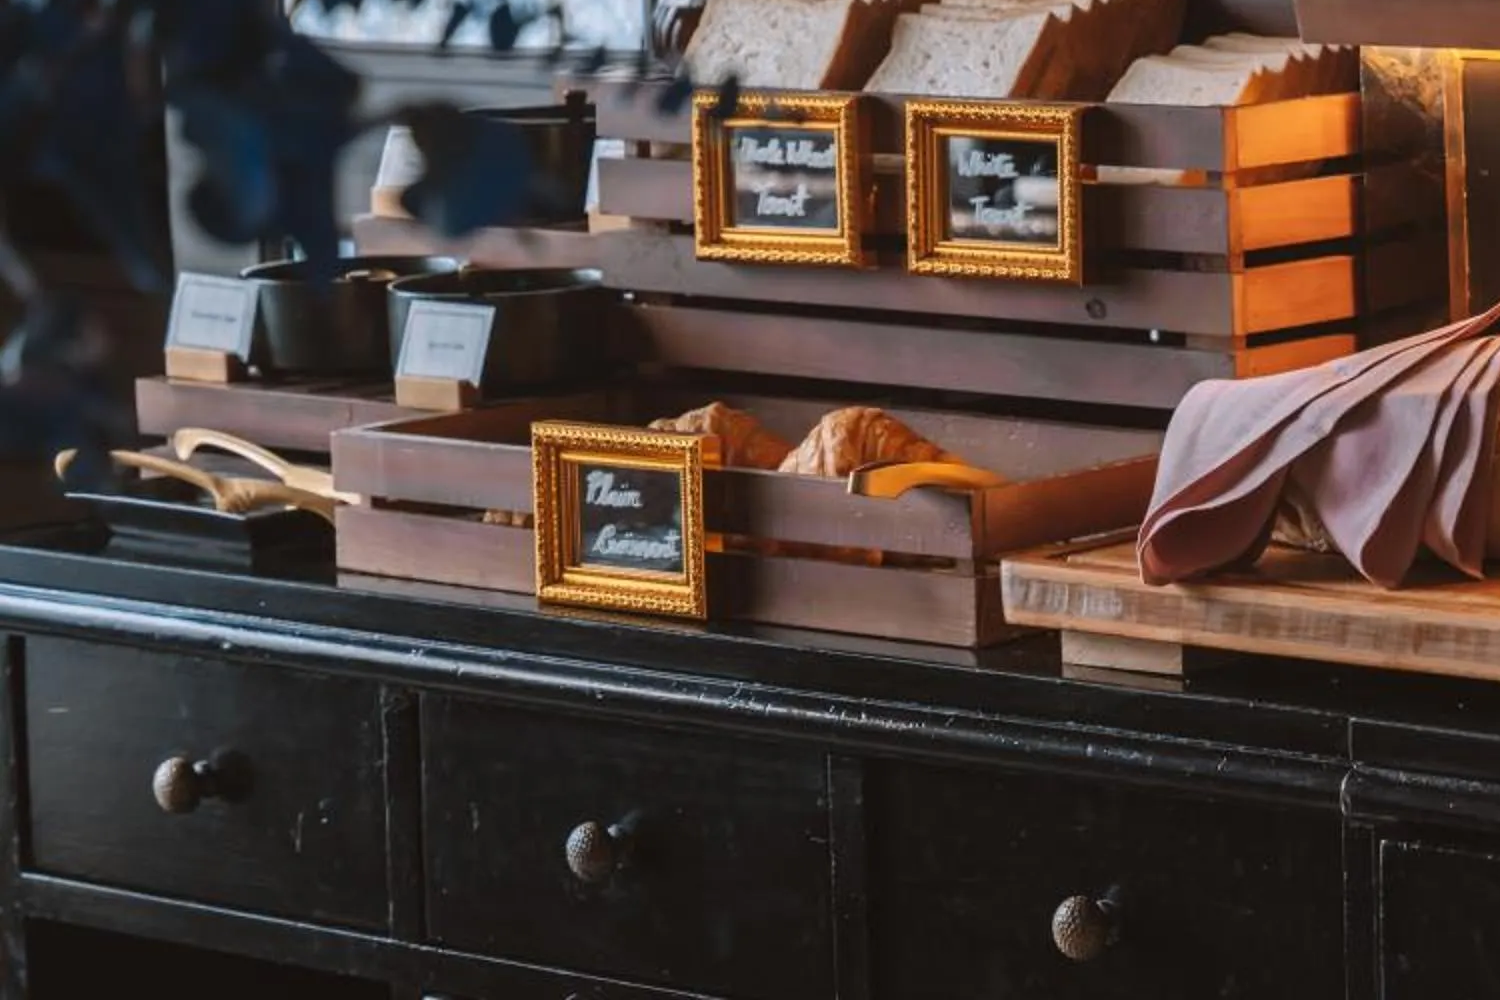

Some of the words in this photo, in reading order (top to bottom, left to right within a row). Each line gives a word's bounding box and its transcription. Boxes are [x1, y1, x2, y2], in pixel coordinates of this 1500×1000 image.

[957, 151, 1018, 179] White
[749, 181, 812, 218] Toast
[968, 195, 1035, 225] Toast
[586, 470, 644, 508] Plain
